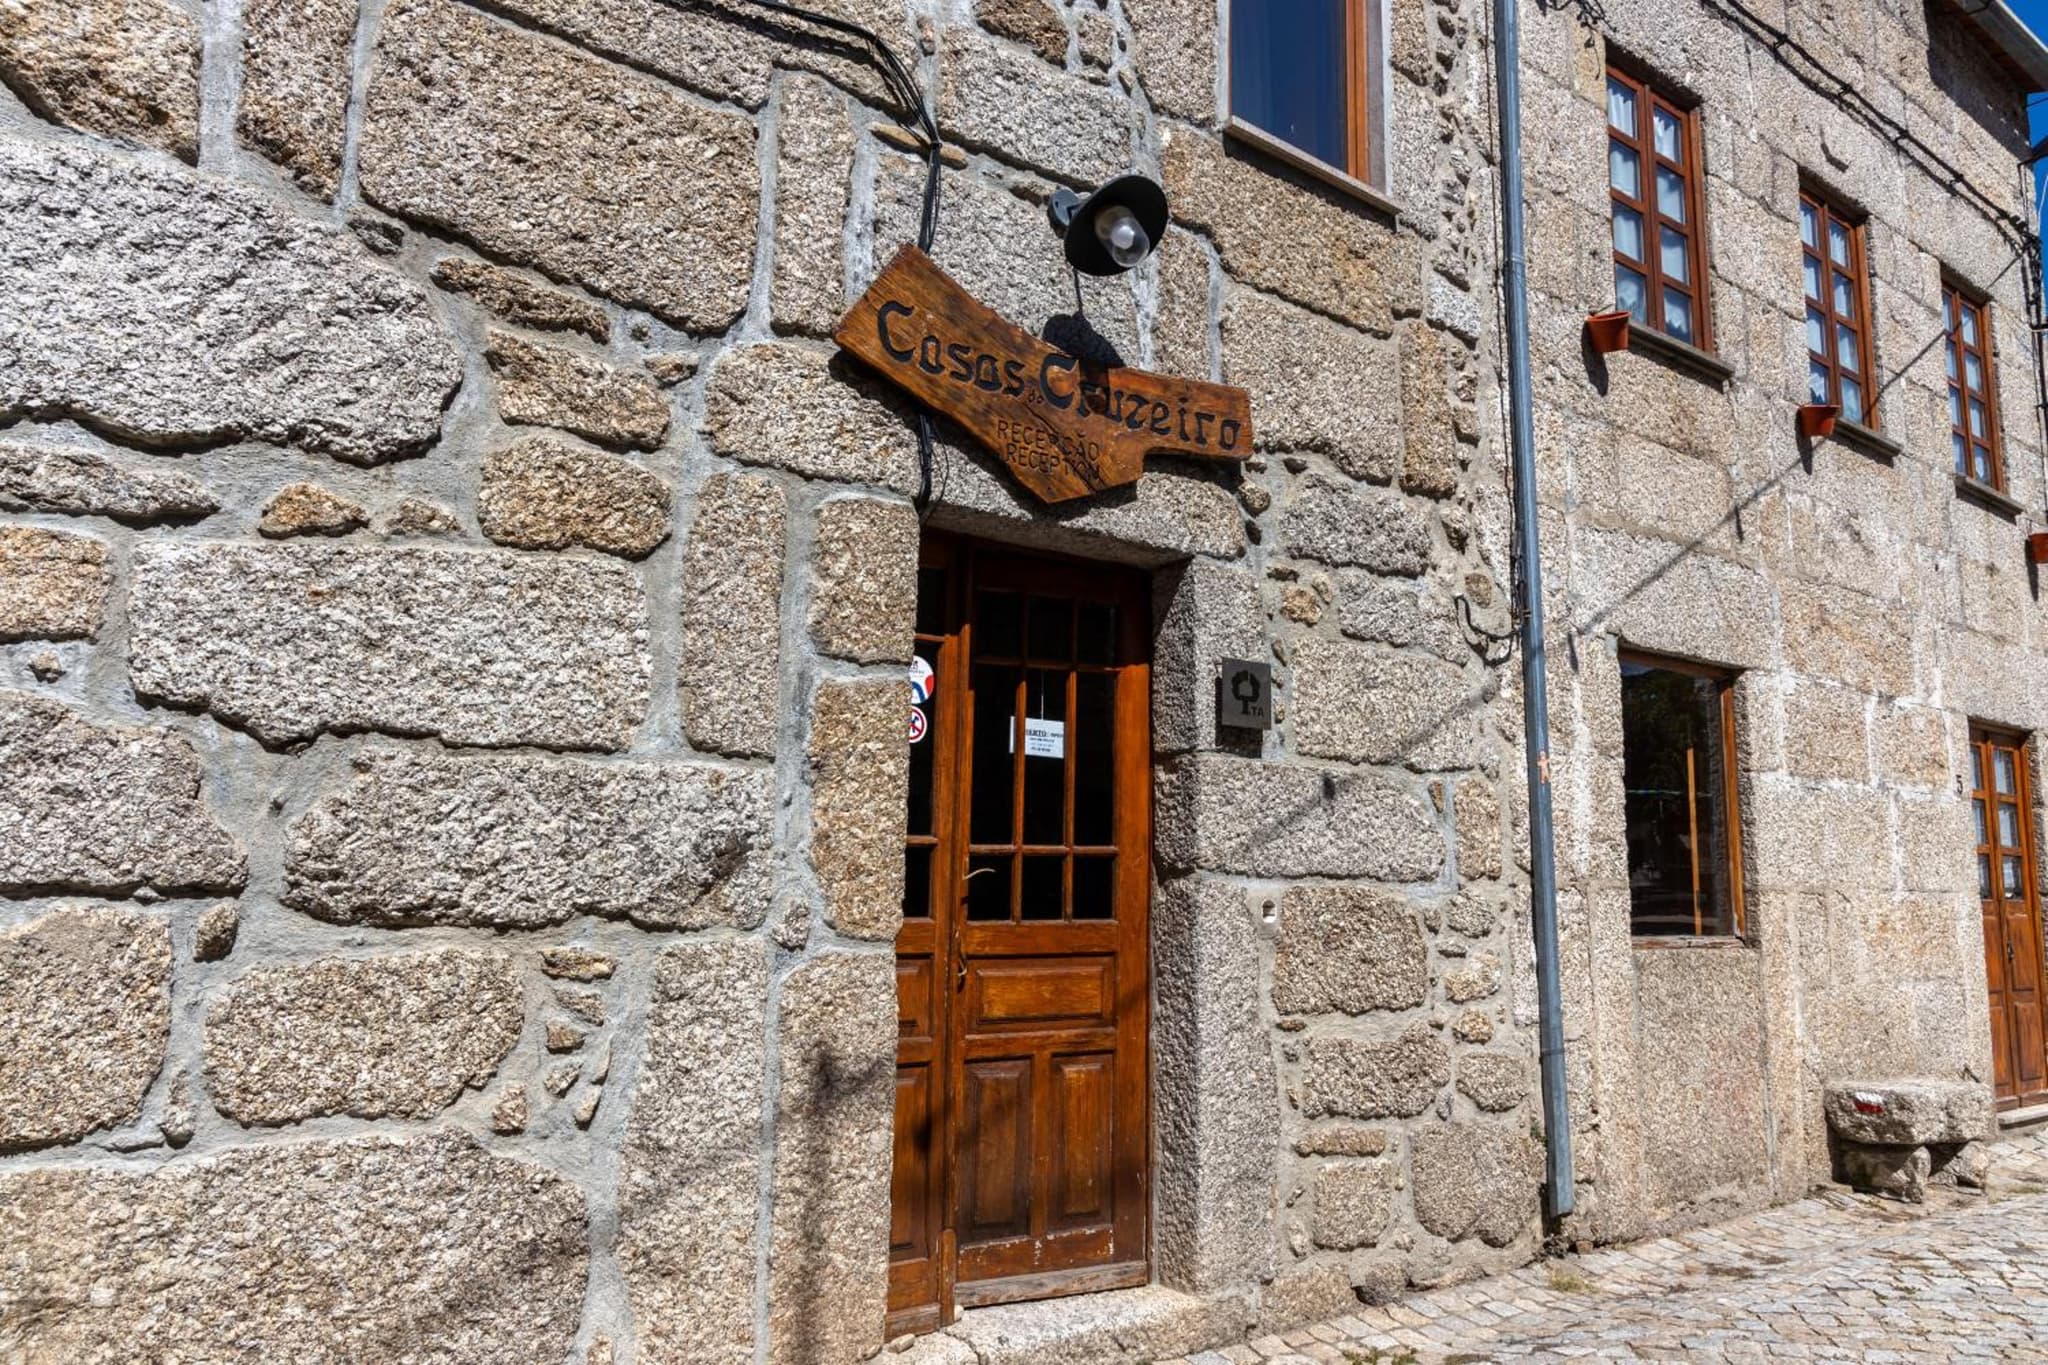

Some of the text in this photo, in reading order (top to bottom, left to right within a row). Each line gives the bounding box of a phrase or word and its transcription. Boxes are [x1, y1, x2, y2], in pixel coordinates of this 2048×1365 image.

[876, 300, 1026, 397] Casas
[1039, 353, 1241, 451] Cruzeiro
[998, 419, 1099, 462] RECEPÇÃO
[1251, 706, 1264, 717] TA
[1956, 774, 1963, 795] 5
